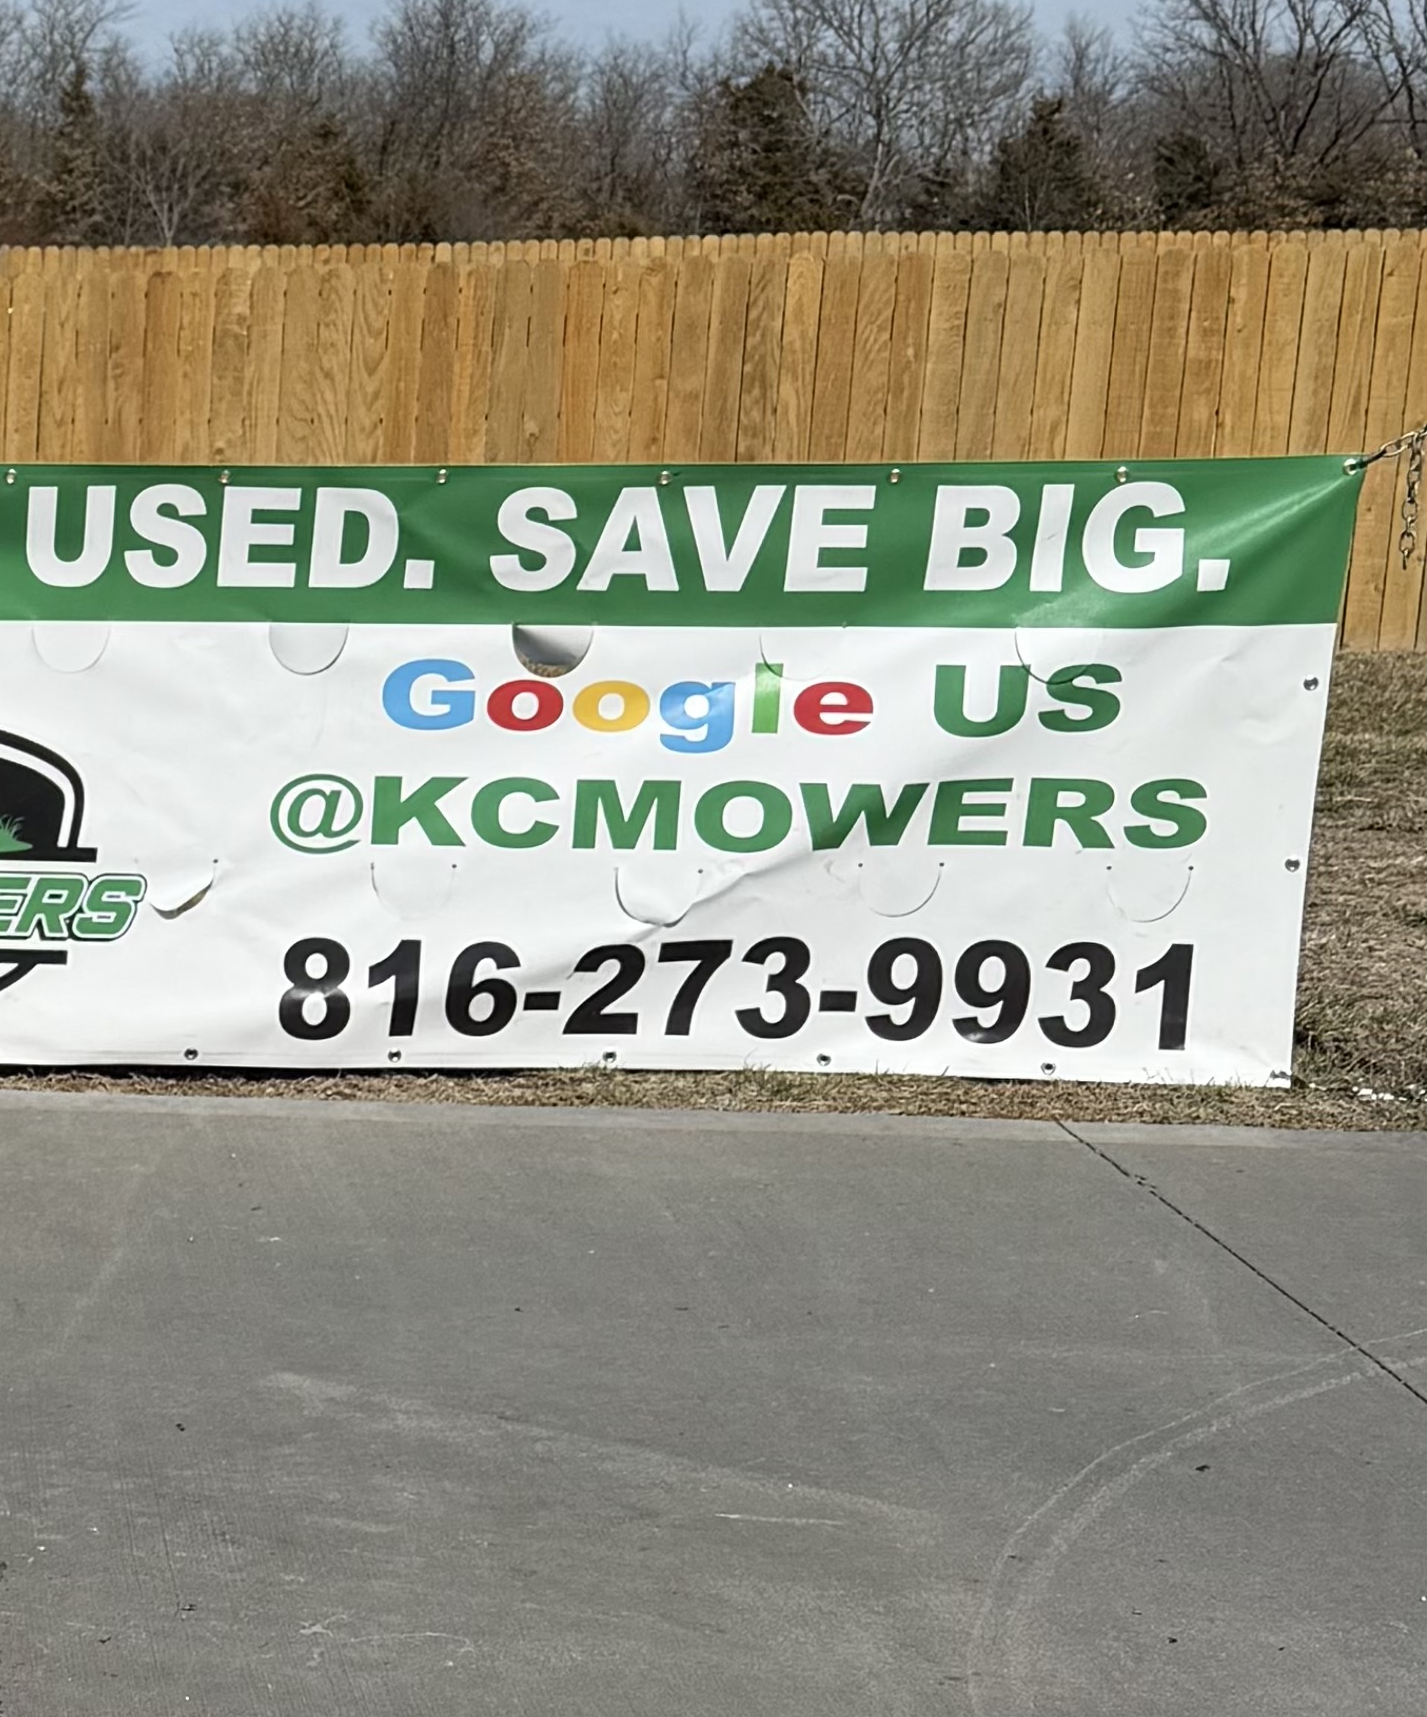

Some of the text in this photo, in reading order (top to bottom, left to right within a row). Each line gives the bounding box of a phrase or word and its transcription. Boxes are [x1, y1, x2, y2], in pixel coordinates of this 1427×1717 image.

[26, 483, 435, 588] USED.
[489, 485, 877, 592] SAVE
[923, 482, 1231, 594] BIG.
[381, 657, 1124, 754] Google US
[269, 773, 1209, 854] @KCMOWERS
[277, 936, 1196, 1051] 816-273-9931
